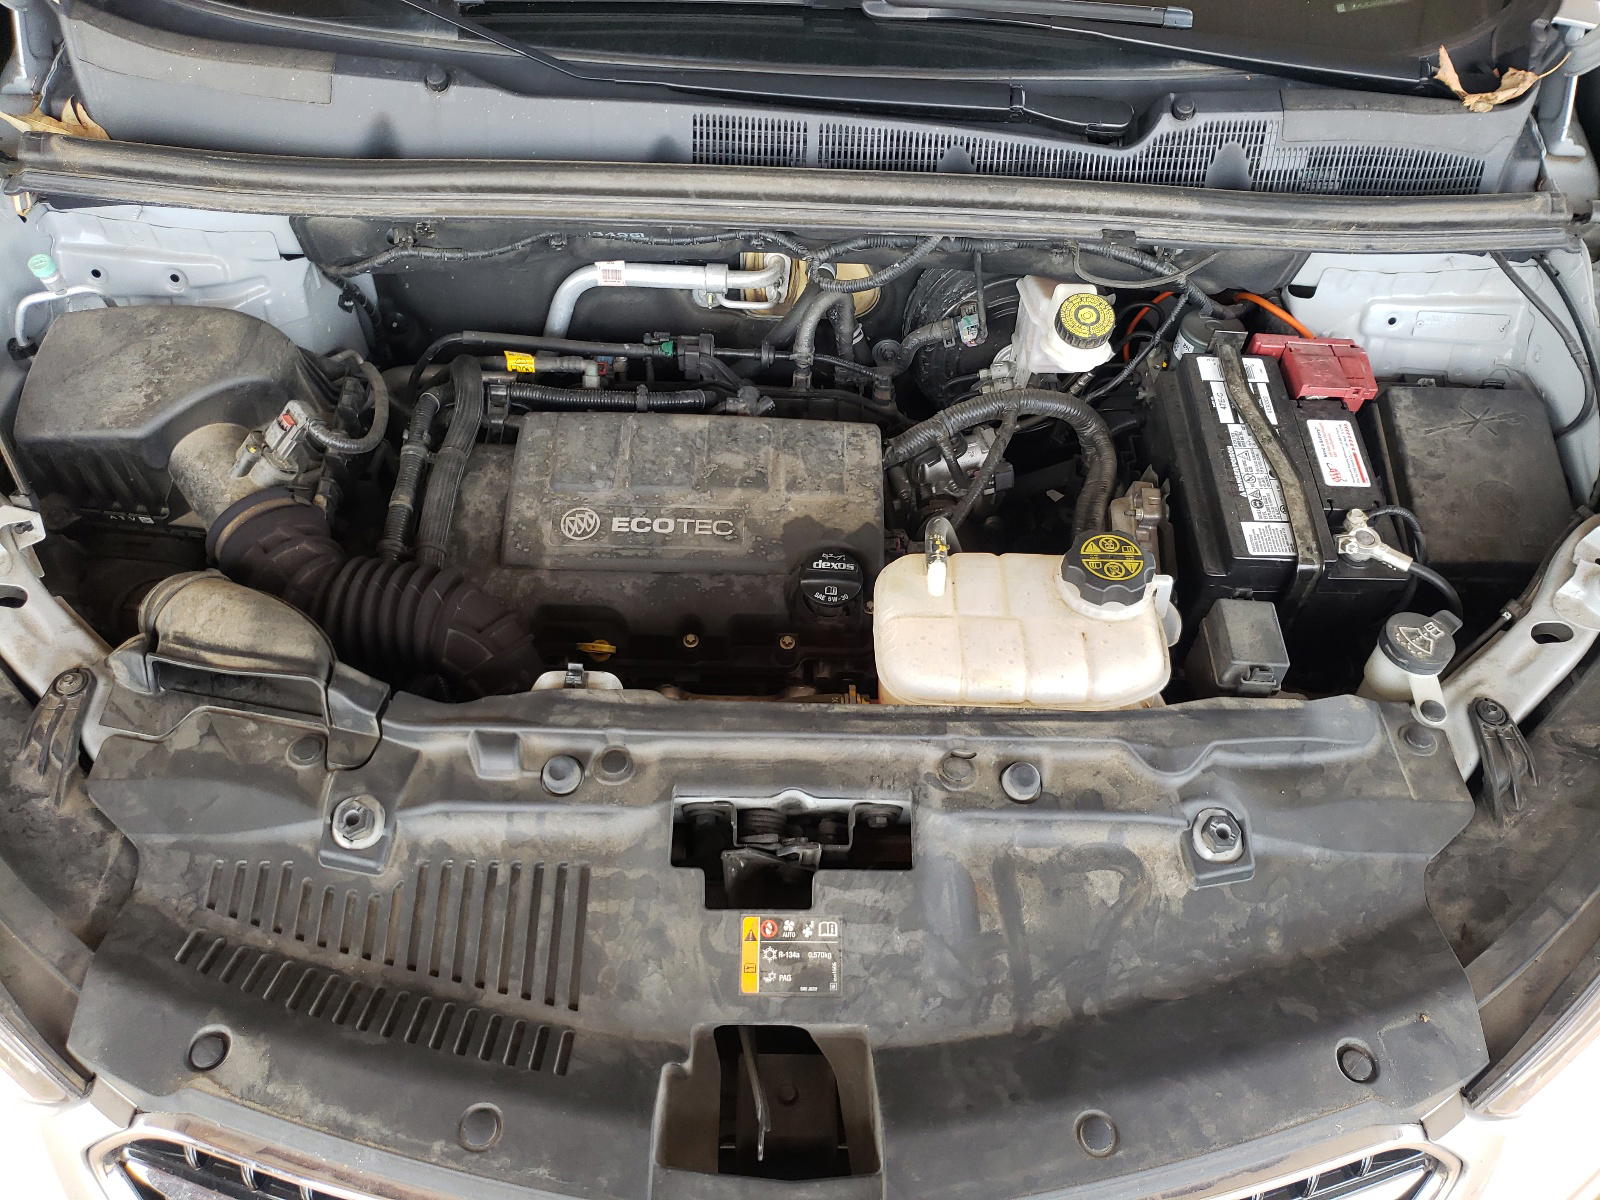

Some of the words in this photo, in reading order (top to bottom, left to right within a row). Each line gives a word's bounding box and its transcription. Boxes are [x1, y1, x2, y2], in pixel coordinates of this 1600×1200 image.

[612, 517, 734, 535] ECOTEC
[812, 560, 855, 570] dexos
[814, 592, 827, 601] SAE
[778, 951, 800, 959] R-134a
[779, 974, 792, 982] PAG
